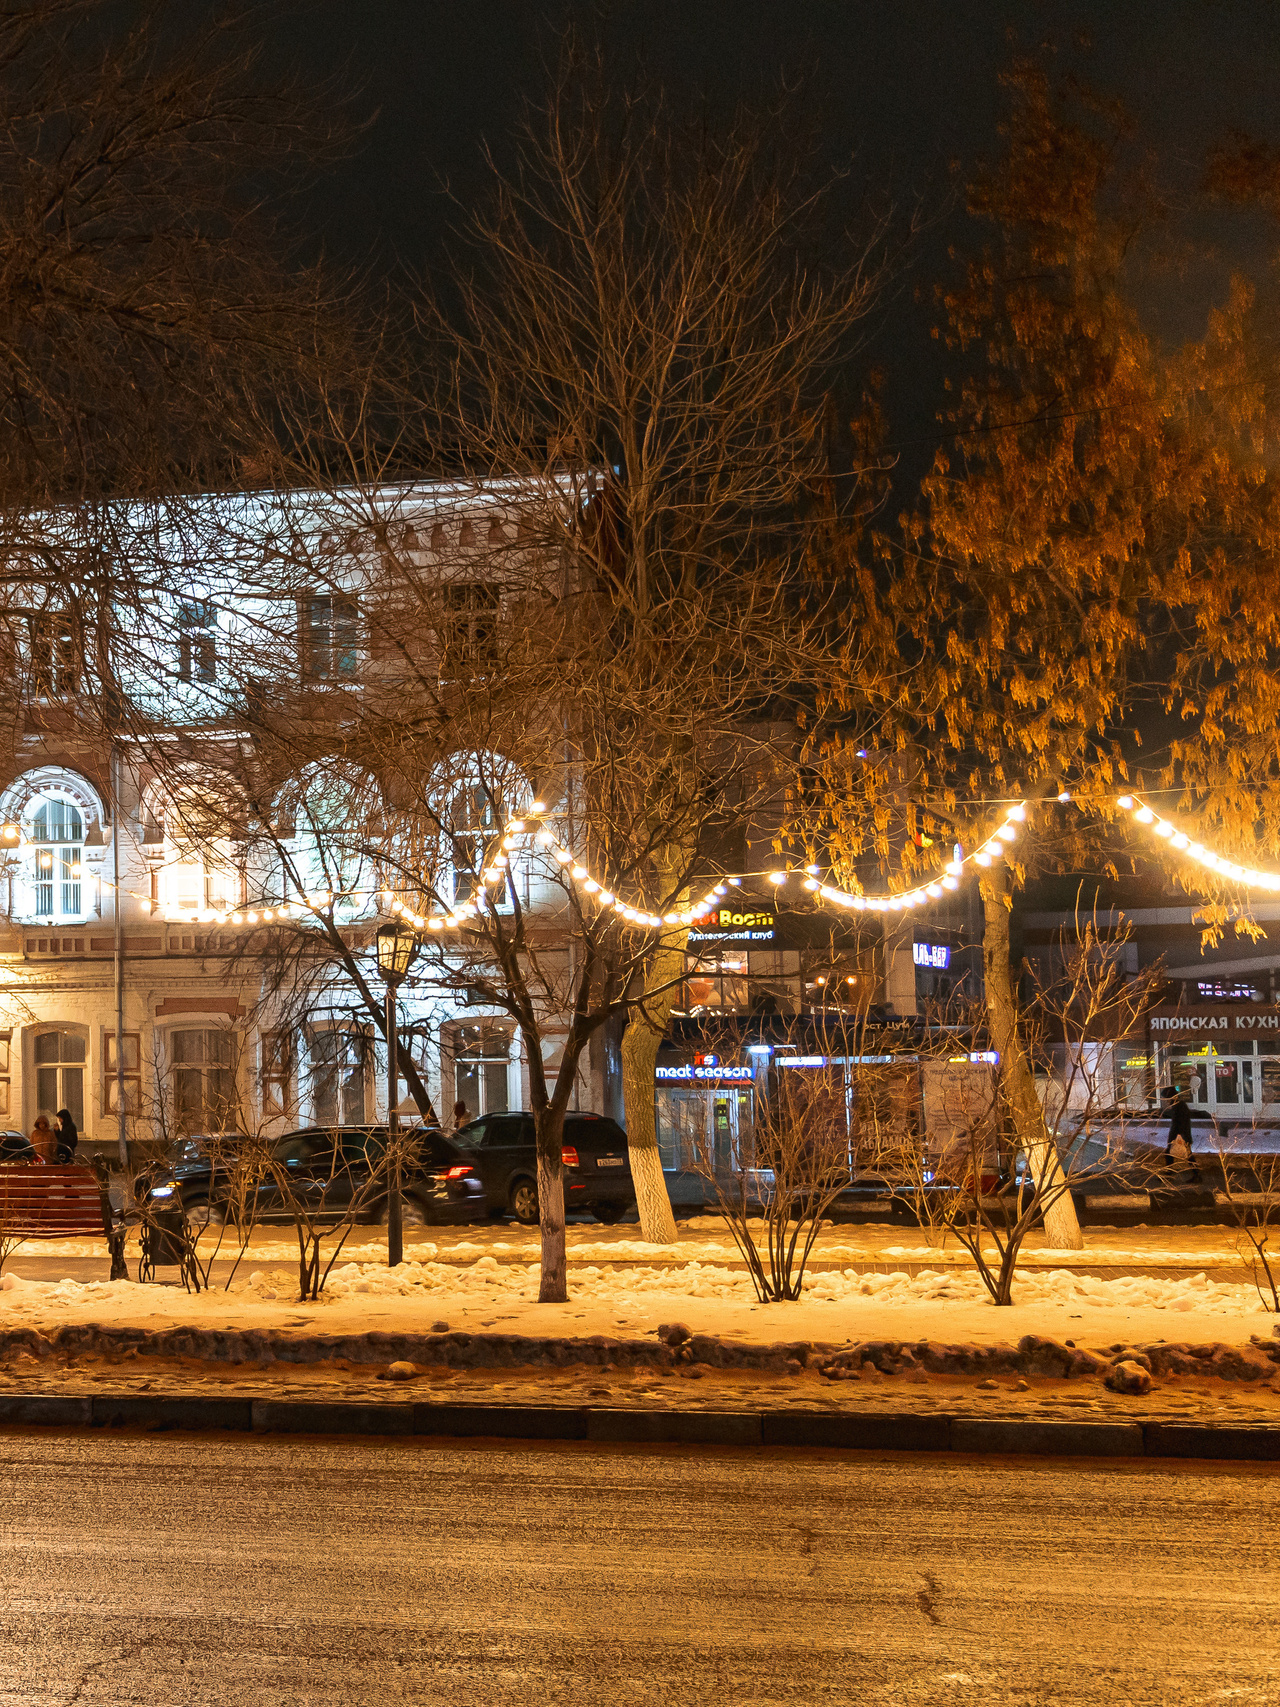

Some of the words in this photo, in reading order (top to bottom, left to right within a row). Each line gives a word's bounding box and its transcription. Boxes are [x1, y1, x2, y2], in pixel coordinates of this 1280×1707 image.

[751, 930, 773, 941] клуб
[1150, 1016, 1228, 1030] ЯПОНСКАЯ
[655, 1063, 692, 1078] meat
[694, 1067, 752, 1078] season
